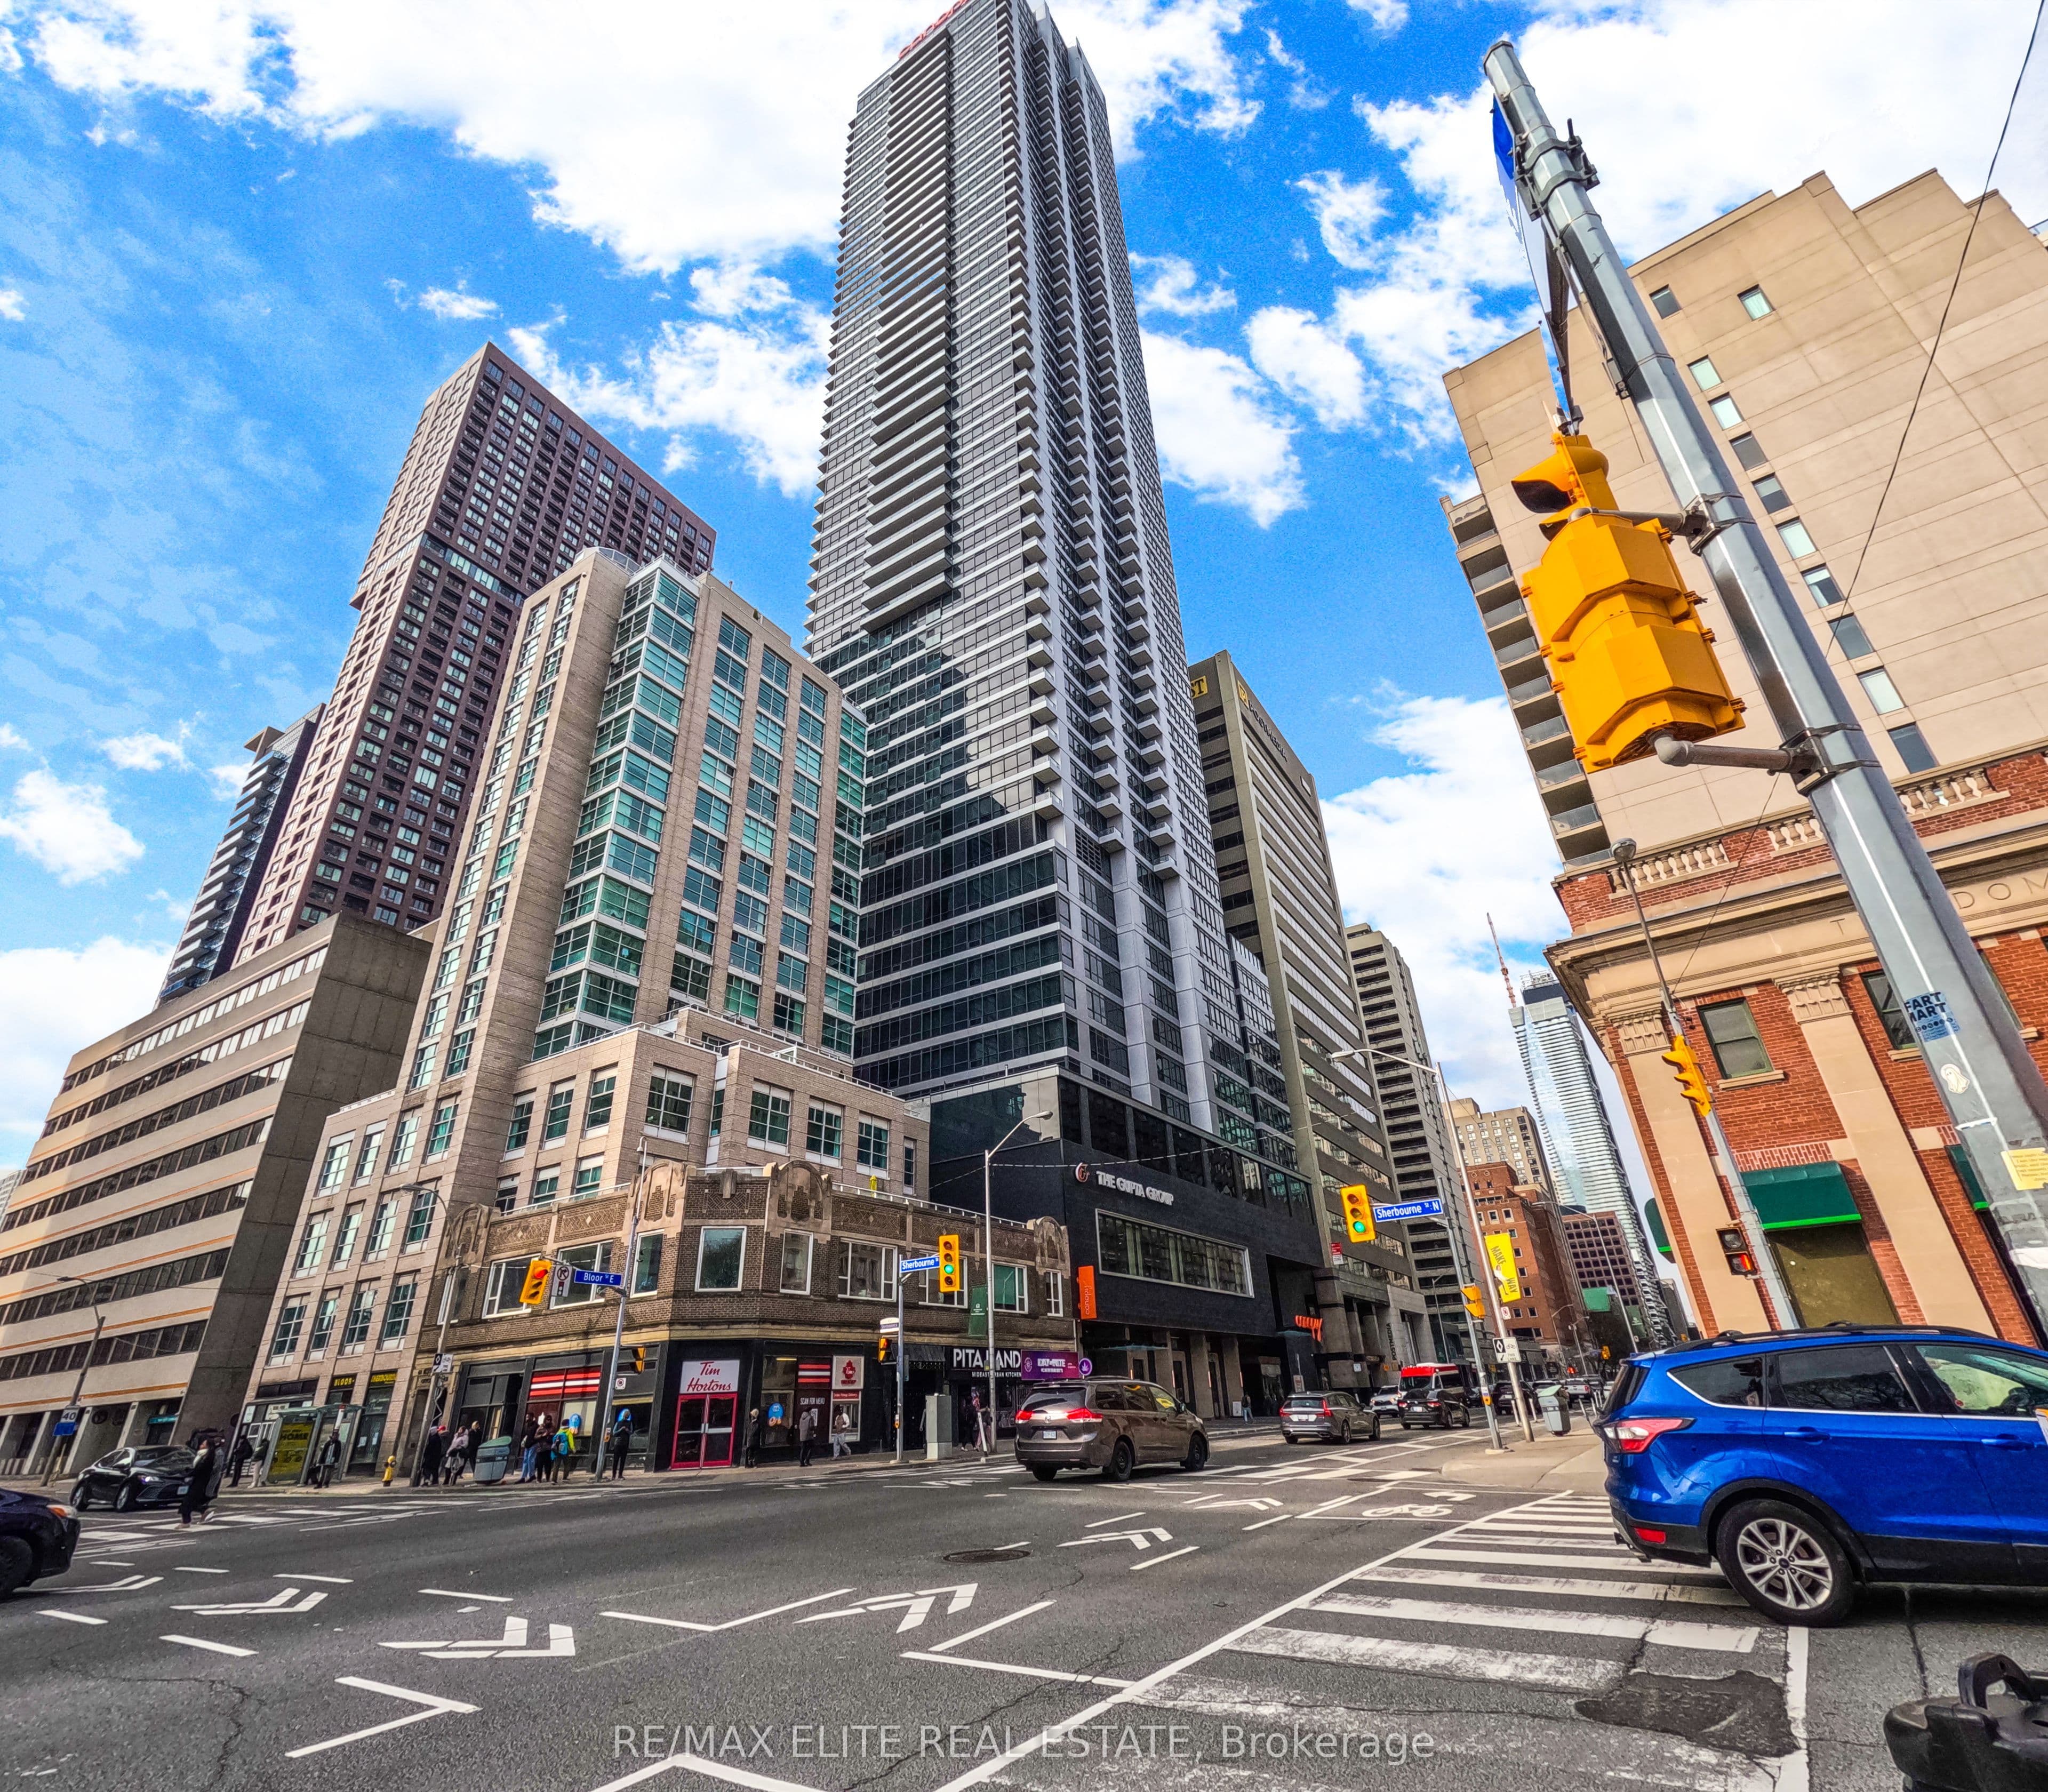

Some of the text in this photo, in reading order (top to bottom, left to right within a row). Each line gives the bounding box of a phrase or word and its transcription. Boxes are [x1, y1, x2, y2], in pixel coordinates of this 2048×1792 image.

[1904, 991, 1941, 1012] FART
[1096, 1171, 1116, 1189] THE
[1116, 1178, 1146, 1198] GUPTA
[1146, 1187, 1173, 1205] GROUP
[1377, 1205, 1422, 1219] Sherbourne
[1432, 1201, 1439, 1211] N
[902, 1259, 934, 1270] Sherbourne
[583, 1273, 603, 1282] Bloor
[610, 1275, 614, 1283] E
[1507, 1277, 1518, 1293] WAY
[1084, 1285, 1092, 1315] canopy
[1387, 1323, 1397, 1361] POSTMEDIA
[953, 1349, 983, 1368] PITA
[700, 1361, 721, 1376] Tim
[687, 1377, 732, 1391] Hortons
[63, 1412, 76, 1420] 40
